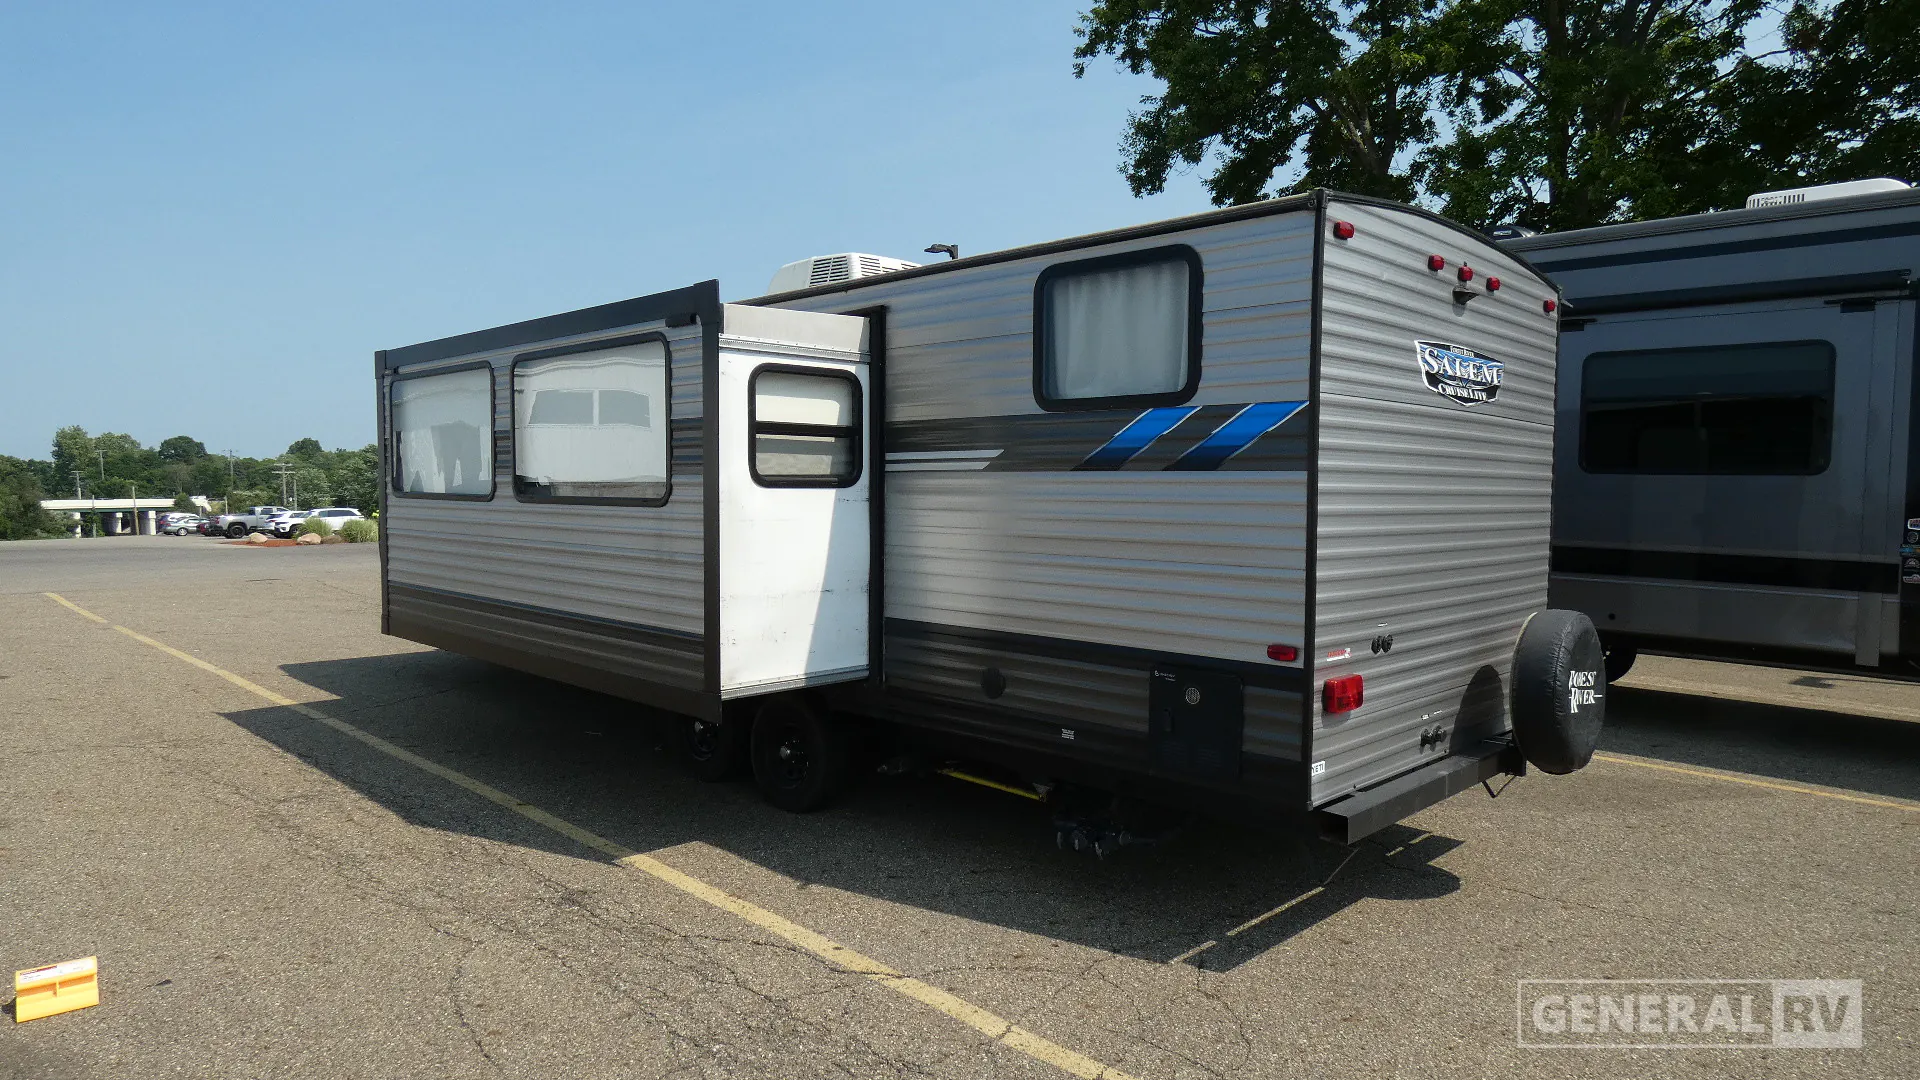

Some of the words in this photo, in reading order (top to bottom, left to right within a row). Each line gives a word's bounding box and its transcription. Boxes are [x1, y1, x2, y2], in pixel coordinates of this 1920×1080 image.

[1424, 348, 1500, 384] SALEM
[1568, 670, 1597, 690] FOREST
[1570, 687, 1596, 713] RIVER
